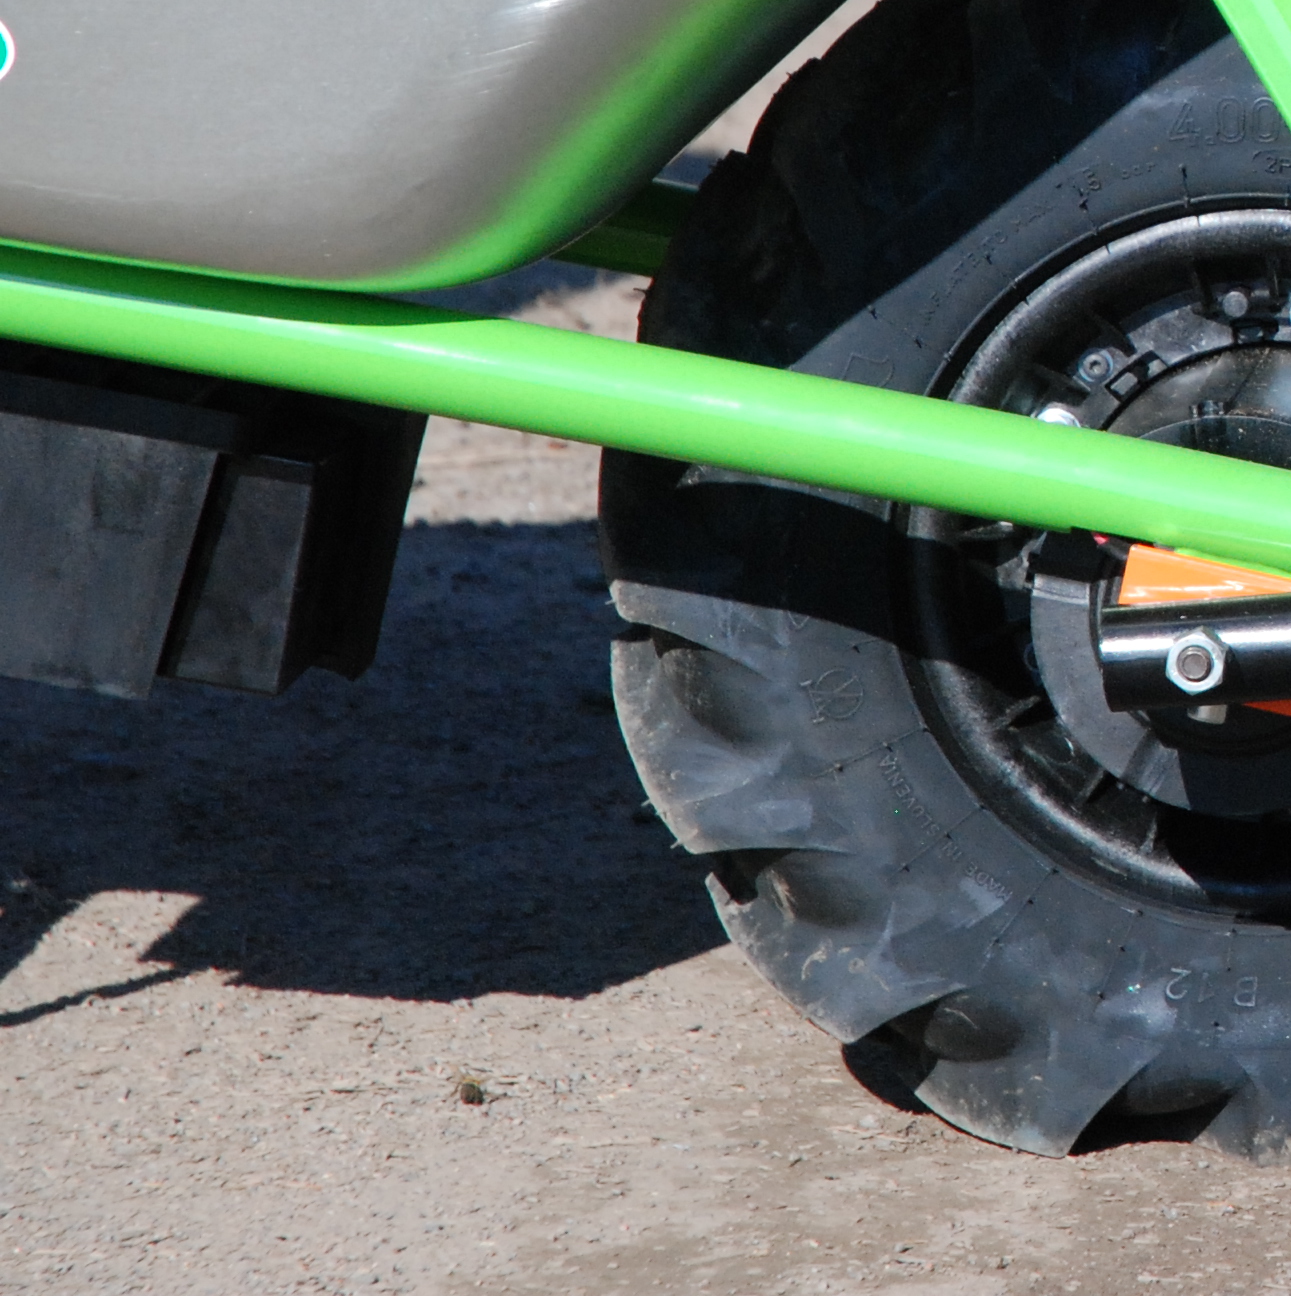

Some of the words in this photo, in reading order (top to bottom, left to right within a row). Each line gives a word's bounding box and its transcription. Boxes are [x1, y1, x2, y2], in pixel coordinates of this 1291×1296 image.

[879, 751, 941, 837] SLOVENIA
[939, 841, 963, 862] IN
[965, 861, 1014, 902] MADE
